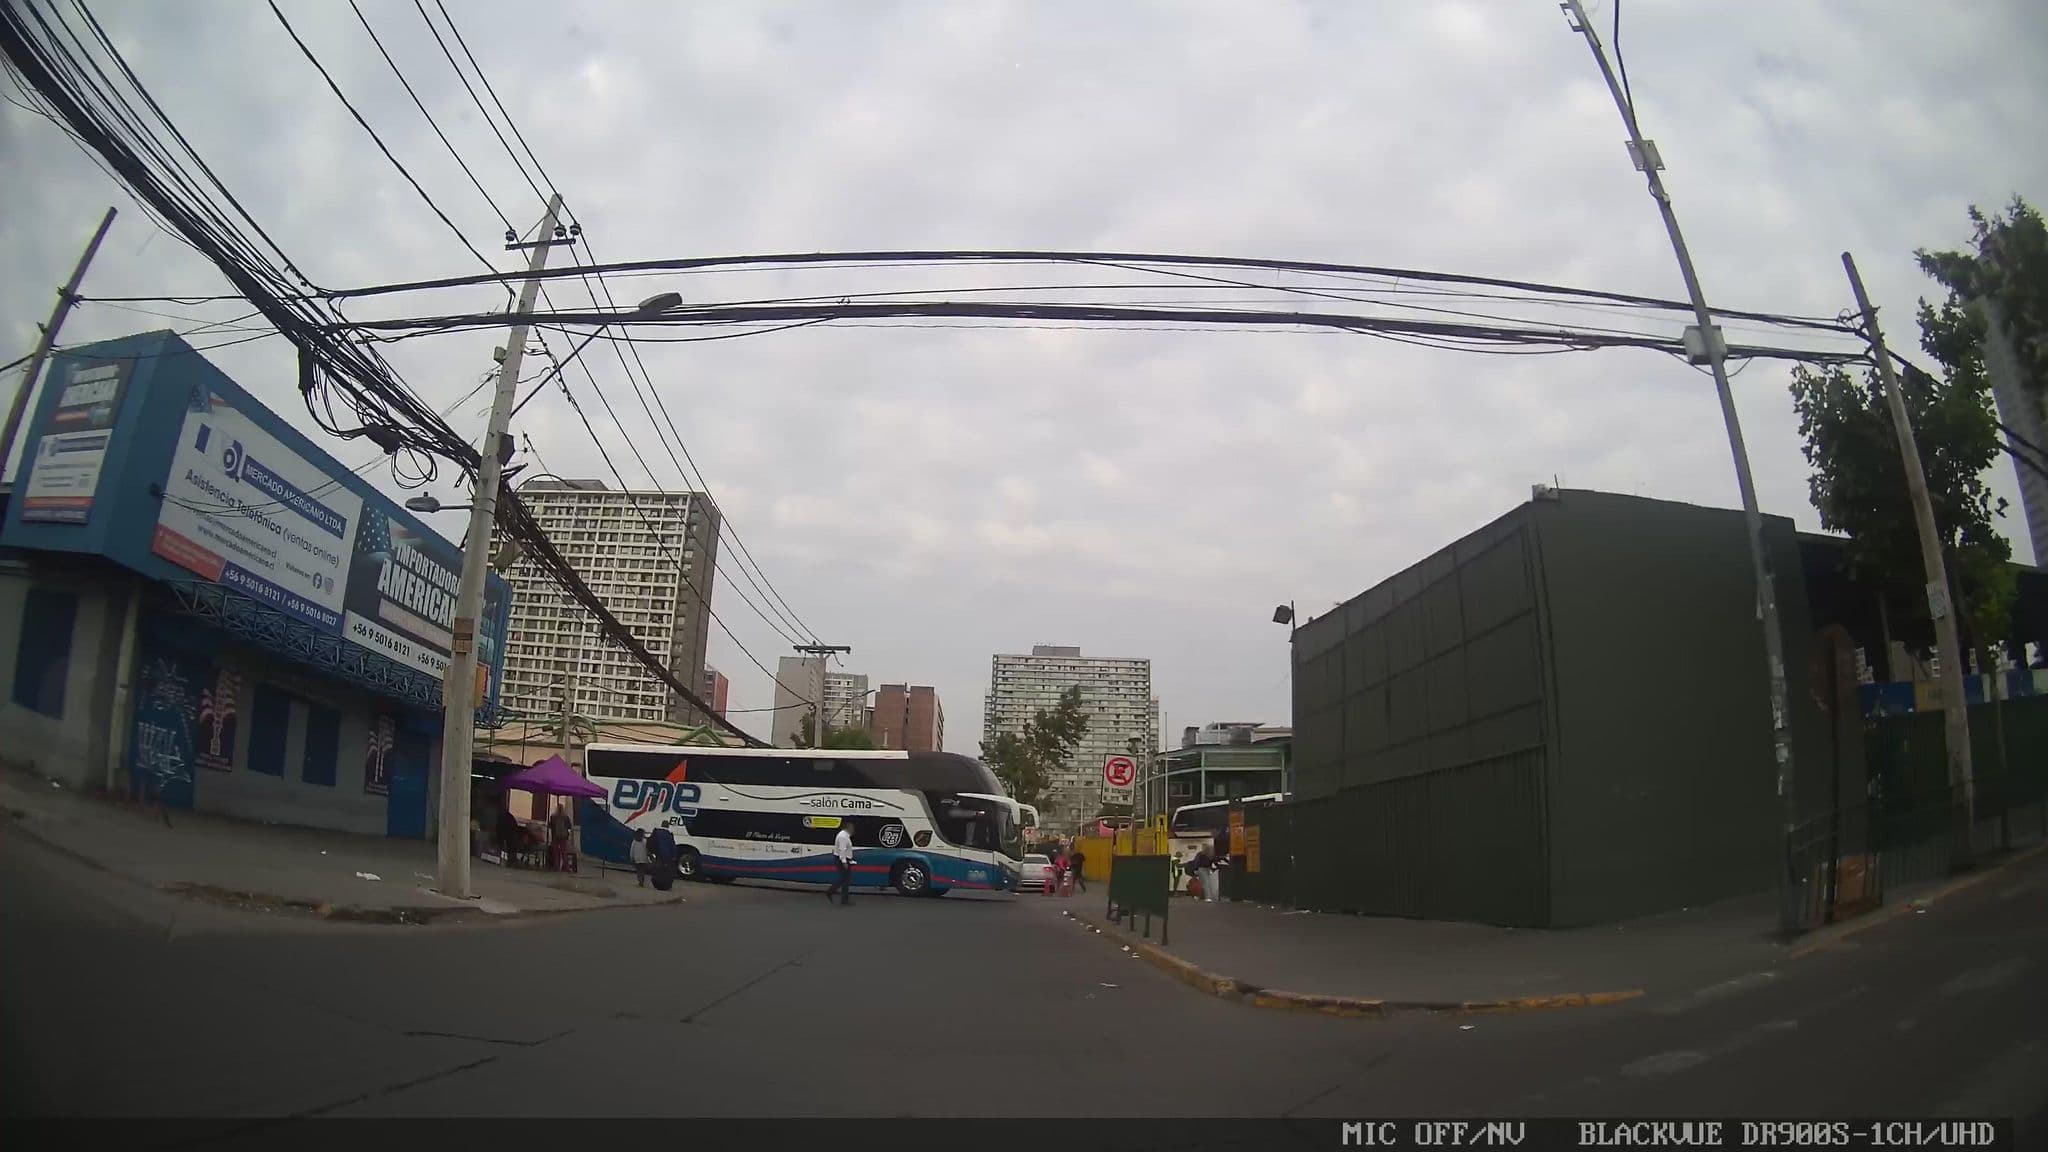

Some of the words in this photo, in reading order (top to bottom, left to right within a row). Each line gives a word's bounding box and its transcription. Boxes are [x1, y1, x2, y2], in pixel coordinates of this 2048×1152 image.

[185, 468, 236, 509] Asistencia
[236, 499, 282, 535] Telefónica
[282, 527, 313, 553] (ventas
[245, 463, 284, 495] MERCADO
[283, 490, 324, 521] AMERICANO
[225, 569, 240, 583] +56
[239, 574, 246, 586] 9
[245, 577, 264, 594] 5016
[299, 603, 305, 613] 9
[305, 606, 321, 620] 5016
[352, 623, 367, 637] +56
[368, 628, 374, 640] 9
[374, 632, 393, 649] 5016
[393, 641, 410, 658] 8121
[417, 652, 430, 666] +56
[430, 657, 436, 669] 9
[612, 779, 701, 818] eme
[810, 793, 839, 809] salón
[840, 798, 873, 810] Cama
